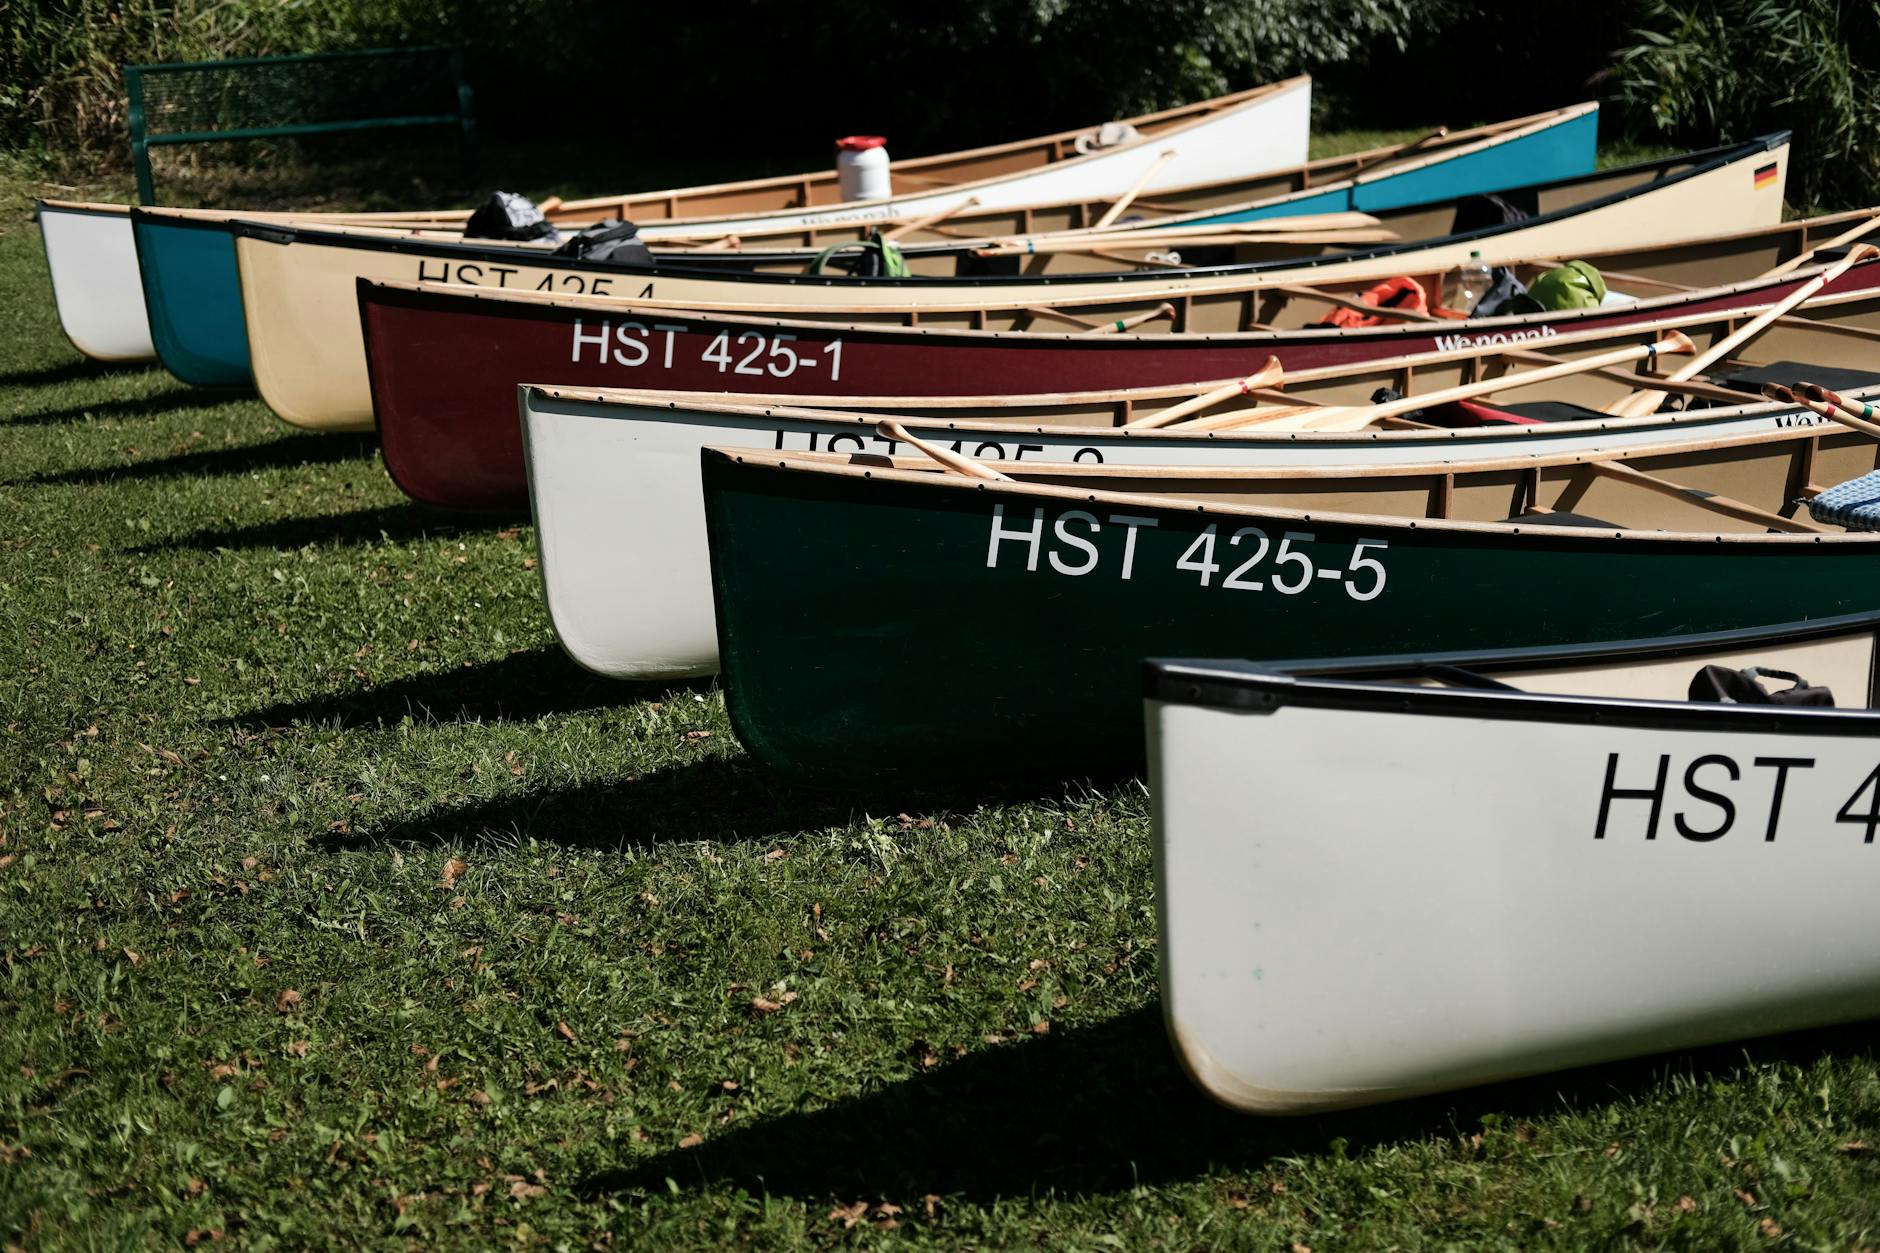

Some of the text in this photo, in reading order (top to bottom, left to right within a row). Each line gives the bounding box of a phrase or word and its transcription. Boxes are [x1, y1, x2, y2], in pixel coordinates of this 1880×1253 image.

[571, 318, 843, 382] HST 425-1
[986, 503, 1389, 601] HST 425-5
[1593, 752, 1816, 843] HST
